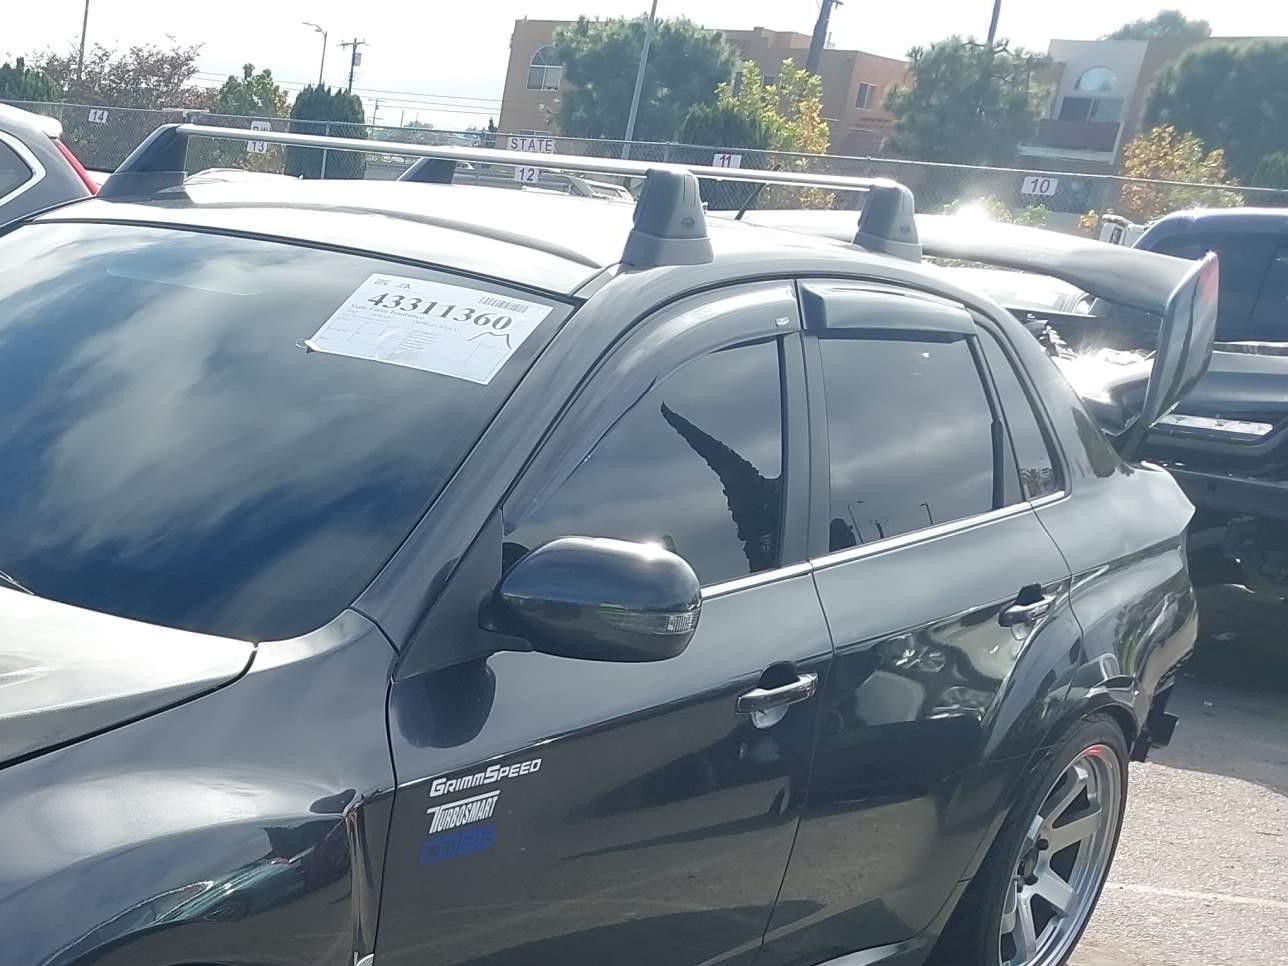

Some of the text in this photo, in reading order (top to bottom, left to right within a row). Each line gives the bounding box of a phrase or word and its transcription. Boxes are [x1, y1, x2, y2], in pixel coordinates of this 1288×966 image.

[92, 110, 105, 121] 14
[252, 141, 265, 152] 13
[510, 137, 553, 152] STATE
[719, 154, 732, 168] 11
[519, 167, 535, 182] 12
[1030, 178, 1051, 194] 10
[367, 292, 513, 331] 43311360
